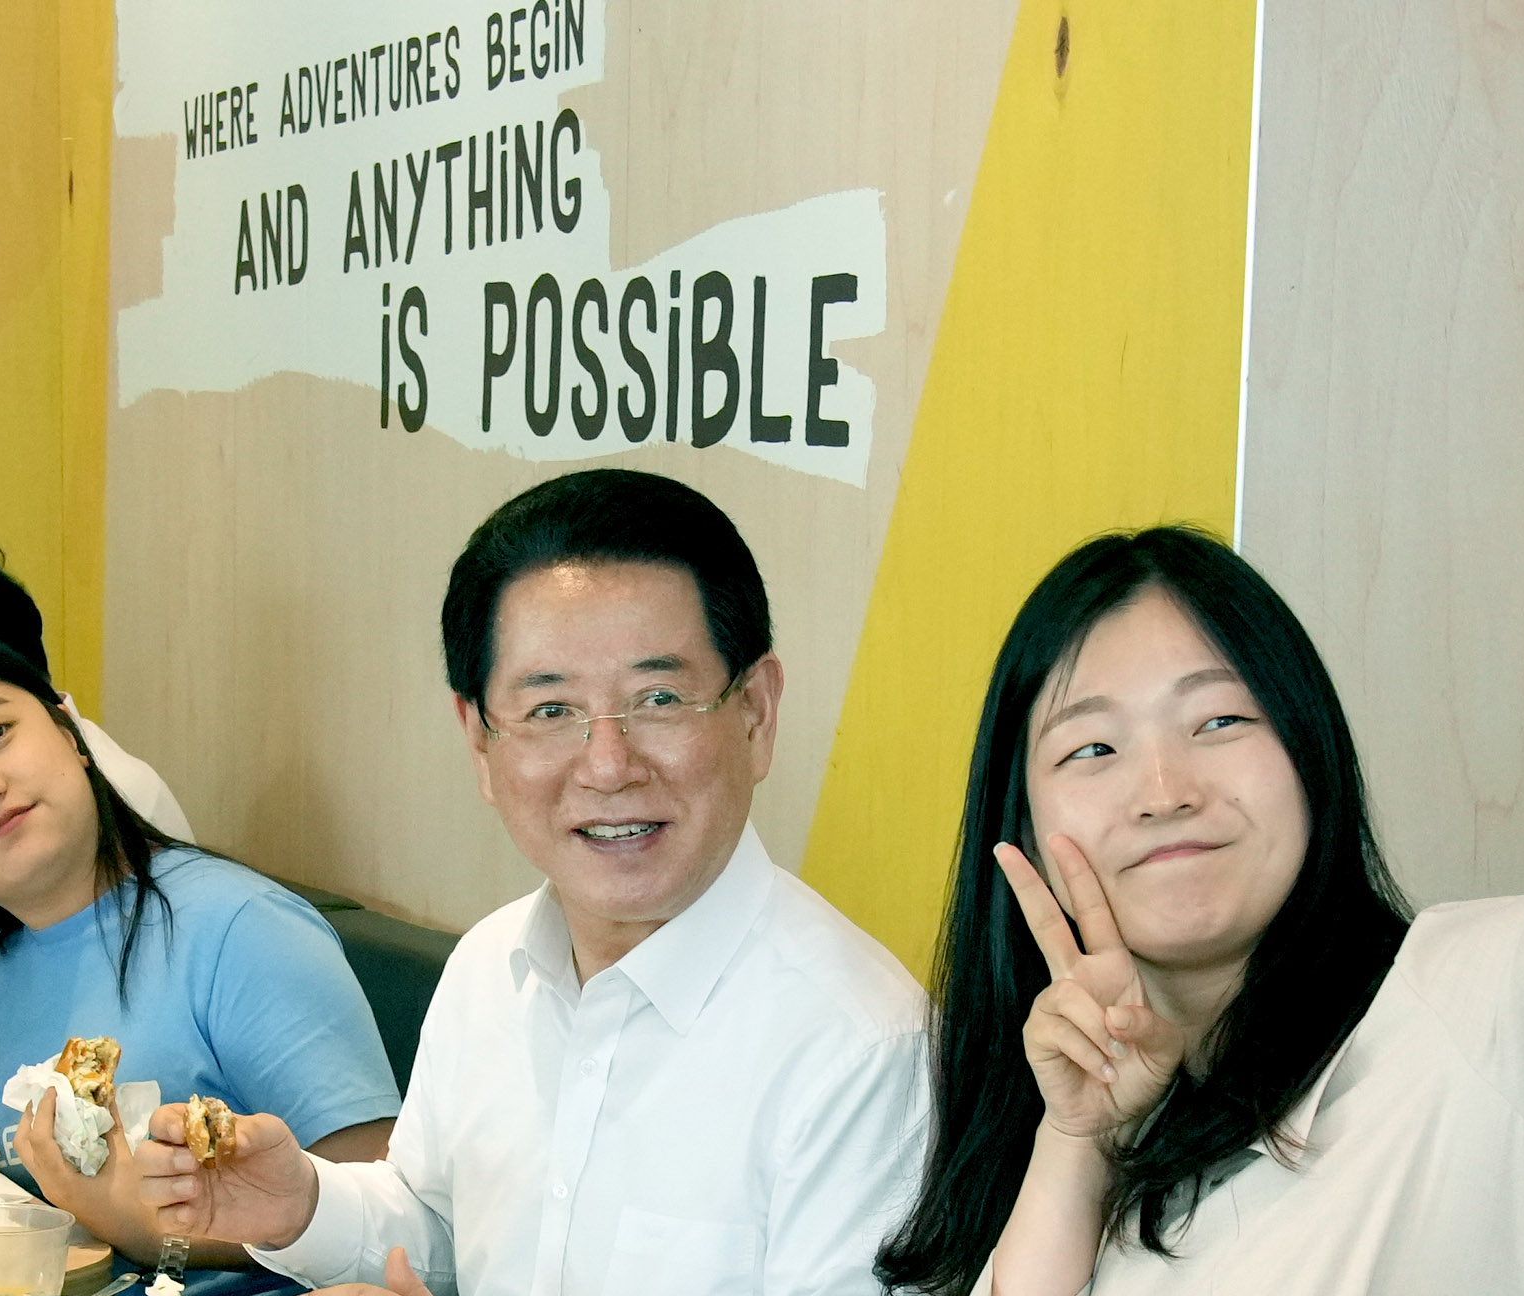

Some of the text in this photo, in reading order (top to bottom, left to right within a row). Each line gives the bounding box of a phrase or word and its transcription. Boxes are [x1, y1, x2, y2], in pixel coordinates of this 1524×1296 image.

[185, 83, 259, 160] WHERE
[280, 26, 461, 138] ADVENTURES
[235, 184, 309, 296] AND
